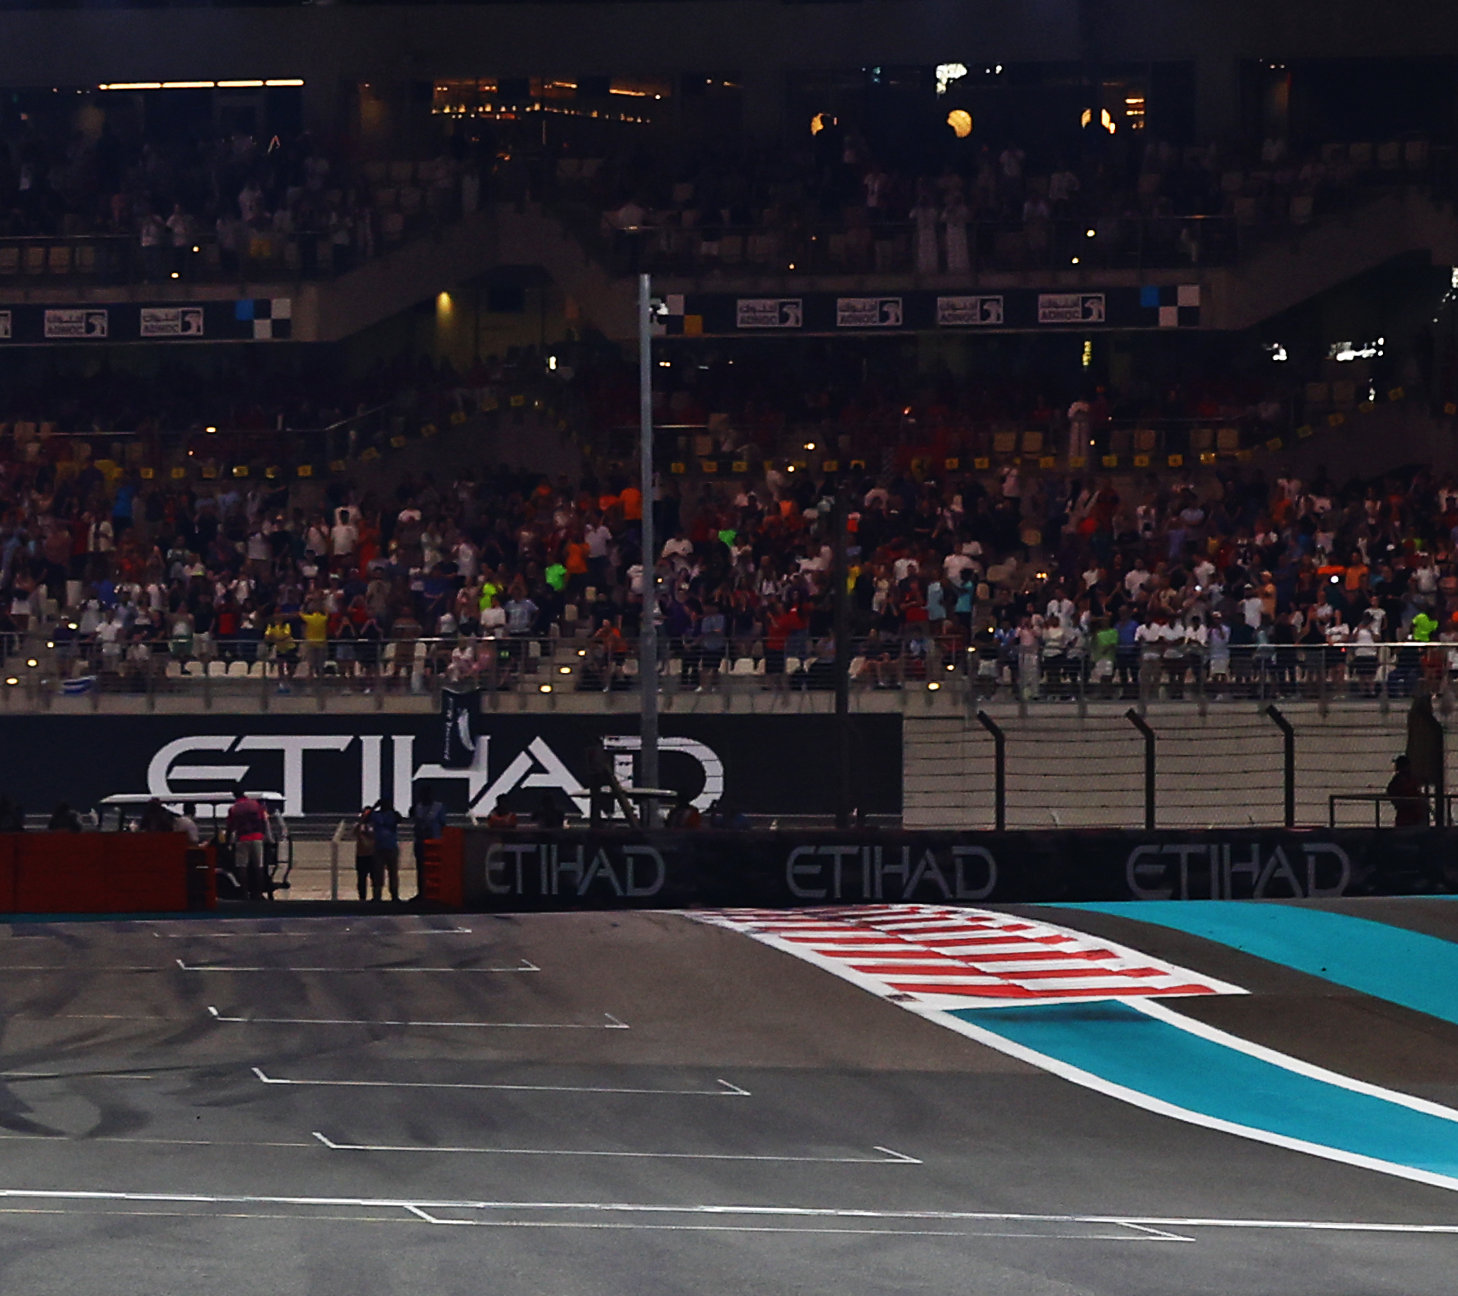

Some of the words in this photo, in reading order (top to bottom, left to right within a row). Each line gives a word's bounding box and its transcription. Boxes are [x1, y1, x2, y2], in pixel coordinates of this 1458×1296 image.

[485, 843, 665, 896] ETIHAD
[786, 845, 999, 899] ETIHAD
[1126, 842, 1351, 899] ETIHAD
